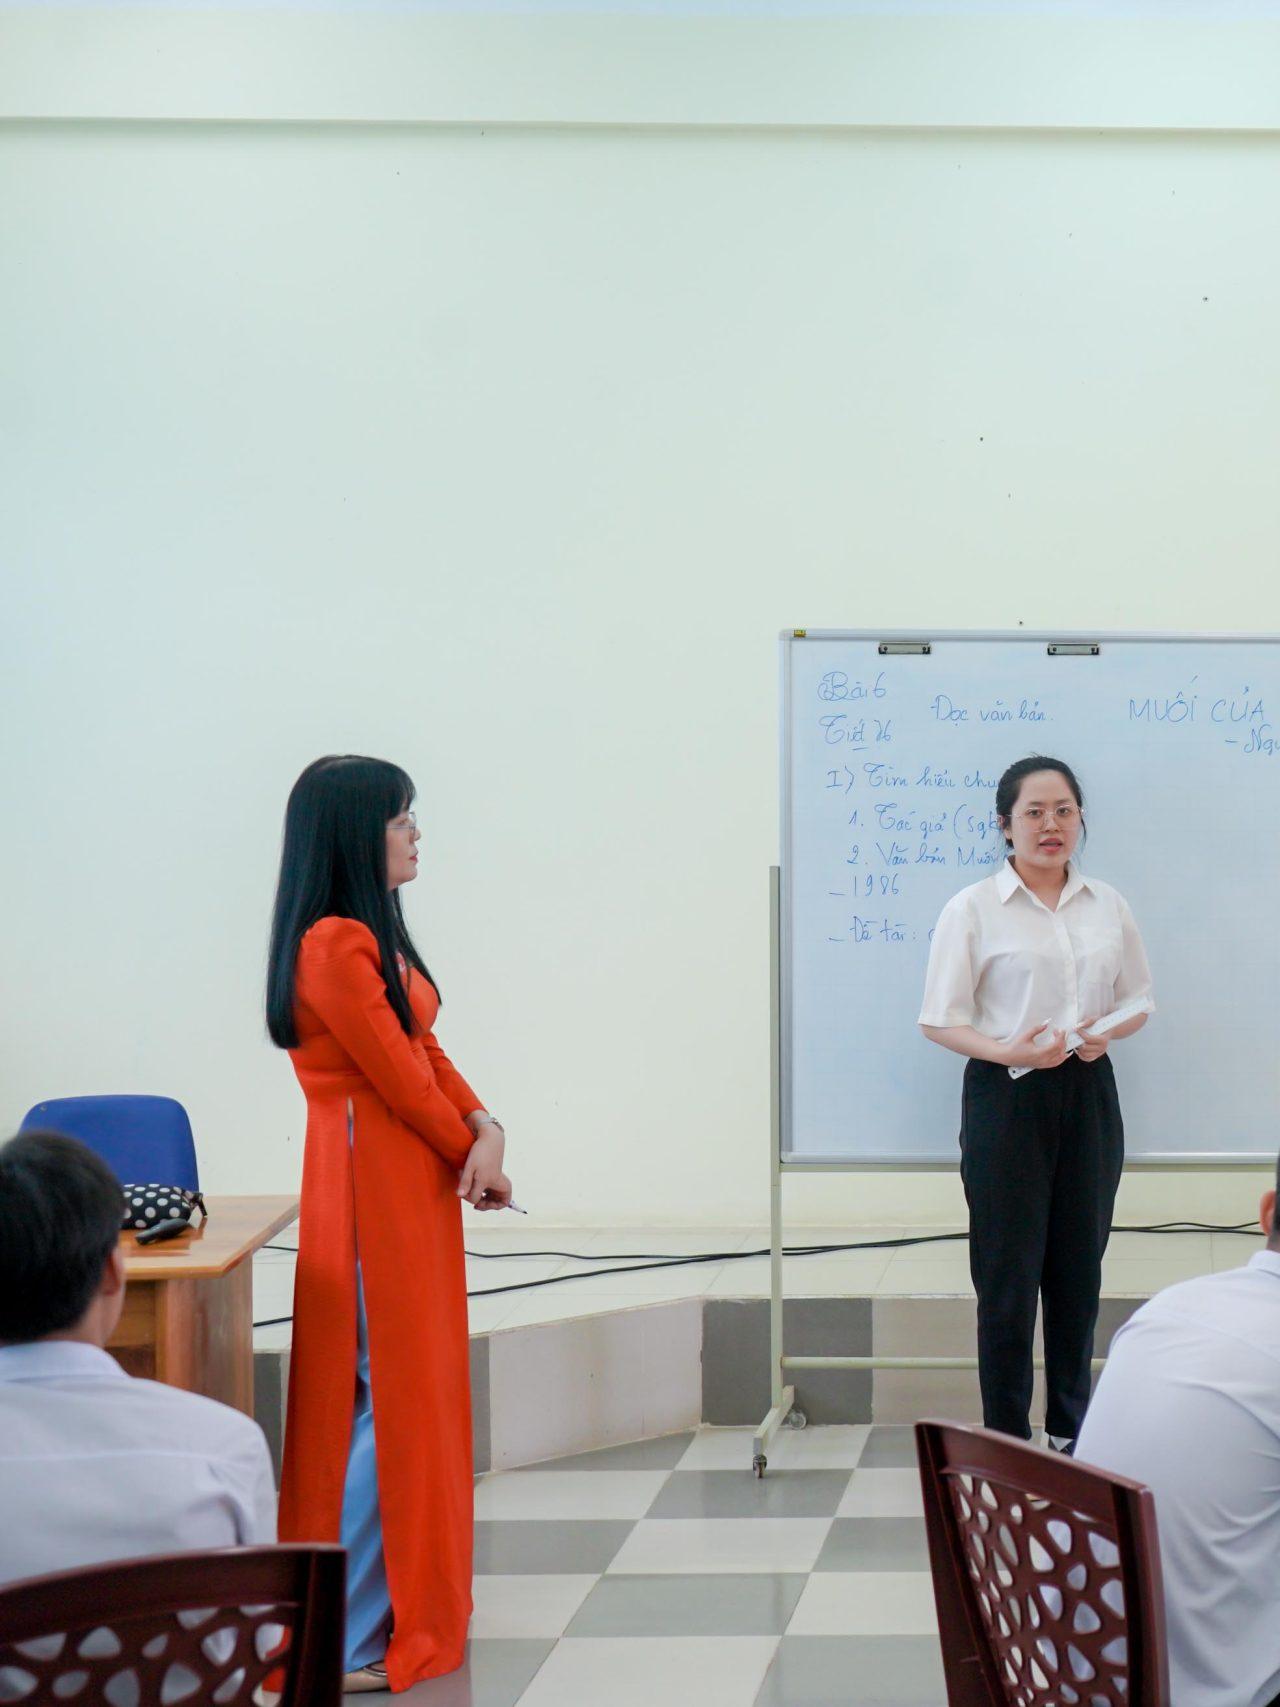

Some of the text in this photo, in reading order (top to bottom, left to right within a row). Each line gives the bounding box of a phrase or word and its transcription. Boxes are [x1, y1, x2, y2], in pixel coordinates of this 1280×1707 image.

[817, 671, 887, 702] Bài 6
[930, 694, 969, 726] Đọc
[979, 699, 1013, 721] văn
[1211, 686, 1264, 722] CỦA
[819, 714, 866, 745] Tiết
[826, 764, 855, 794] I)
[863, 762, 909, 788] Tìm
[916, 766, 955, 788] hiểu
[848, 809, 864, 828] 1.
[874, 802, 915, 831] Tác
[919, 811, 948, 840] giả
[847, 844, 868, 865] 2.
[876, 841, 909, 867] Văn
[914, 842, 946, 865] bản
[852, 873, 901, 897] 1986
